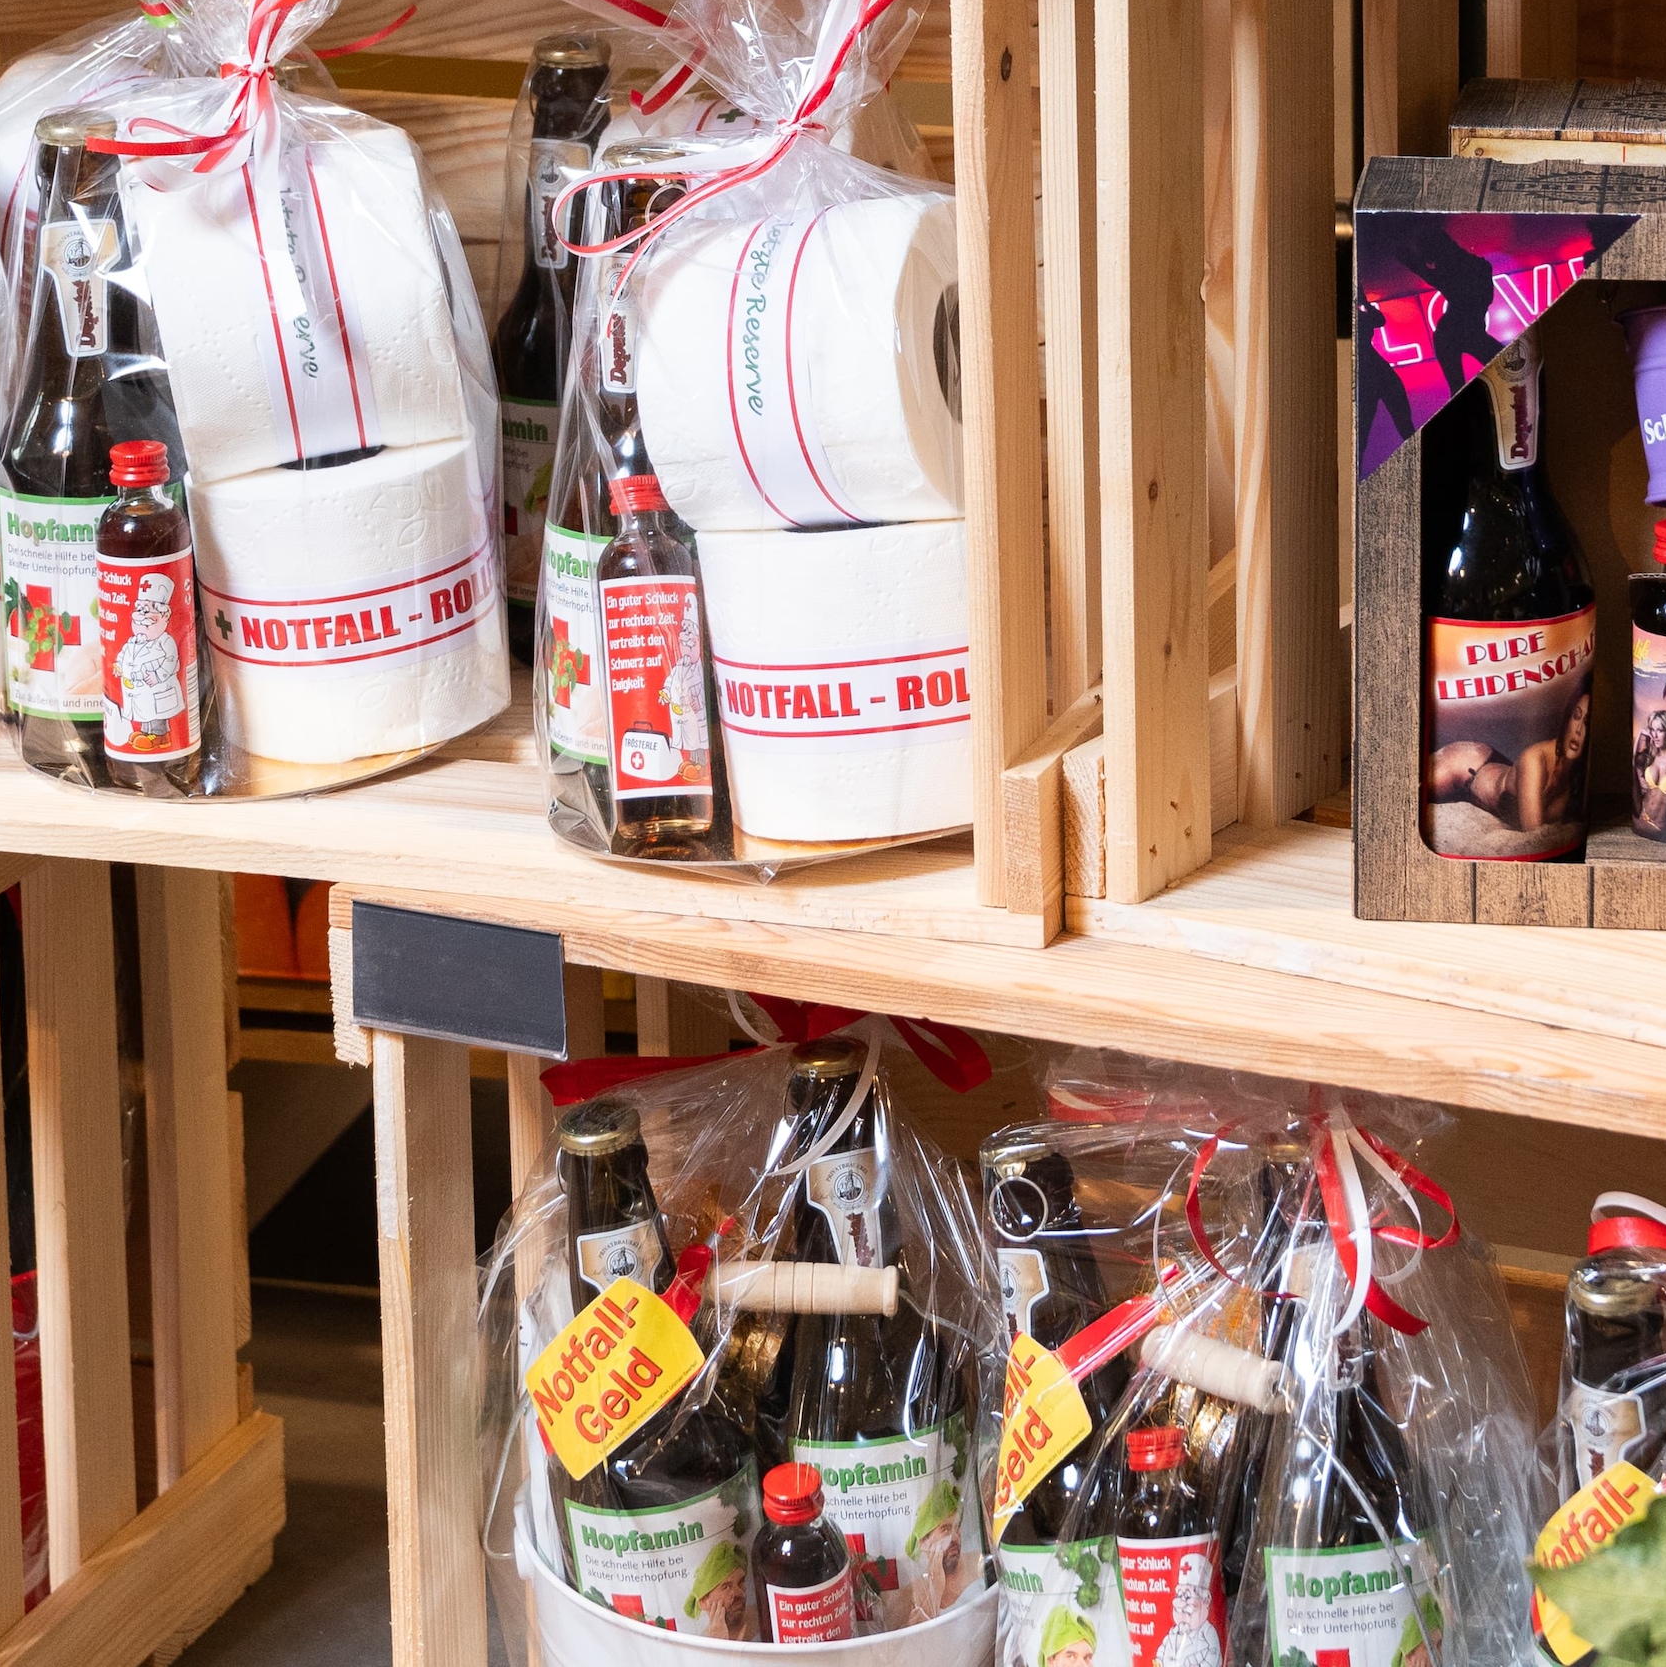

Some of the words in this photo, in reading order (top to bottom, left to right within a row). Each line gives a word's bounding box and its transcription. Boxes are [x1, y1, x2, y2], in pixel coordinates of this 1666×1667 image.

[743, 294, 767, 416] Reserve
[20, 547, 53, 561] schnelle
[55, 551, 78, 562] Hilfe
[81, 551, 96, 562] bei
[104, 573, 132, 586] Schluck
[111, 593, 130, 606] Zeit,
[607, 595, 618, 608] Ein
[619, 594, 643, 610] guter
[645, 592, 678, 604] Schluck
[106, 612, 118, 623] den
[608, 616, 620, 629] zur
[621, 613, 656, 628] rechten
[658, 613, 677, 626] Zeit,
[106, 630, 116, 642] auf
[239, 605, 401, 651] NOTFALL
[609, 634, 646, 650] vertreibt
[648, 634, 665, 647] den
[1465, 630, 1546, 666] PURE
[610, 656, 644, 671] Schmerz
[646, 654, 662, 667] auf
[612, 676, 645, 694] Ewigkeit
[62, 697, 80, 708] und
[726, 677, 861, 719] NOTFALL
[624, 738, 658, 751] TRÖSTERLE
[533, 1297, 639, 1426] Notfall-
[574, 1346, 663, 1443] Geld
[994, 1407, 1054, 1508] Geld
[866, 1492, 891, 1506] Hilfe
[893, 1490, 908, 1503] bei
[840, 1505, 912, 1521] Unterhopfung.
[580, 1519, 704, 1557] Hopfamin
[585, 1554, 599, 1567] Die
[601, 1556, 638, 1571] schnelle
[641, 1556, 670, 1570] Hilfe
[672, 1554, 685, 1567] bei
[1137, 1555, 1171, 1572] Schluck
[587, 1569, 614, 1581] akuter
[617, 1567, 690, 1583] Unterhopfung.
[1149, 1578, 1170, 1594] Zeit,
[778, 1599, 794, 1613] Ein
[795, 1596, 821, 1614] guter
[1140, 1600, 1157, 1615] den
[1287, 1607, 1303, 1619] Die
[1305, 1606, 1350, 1620] schnelle
[1352, 1604, 1376, 1618] Hilfe
[1379, 1601, 1395, 1613] bei
[780, 1616, 796, 1629] zur
[799, 1611, 833, 1631] rechten
[1140, 1621, 1155, 1636] auf
